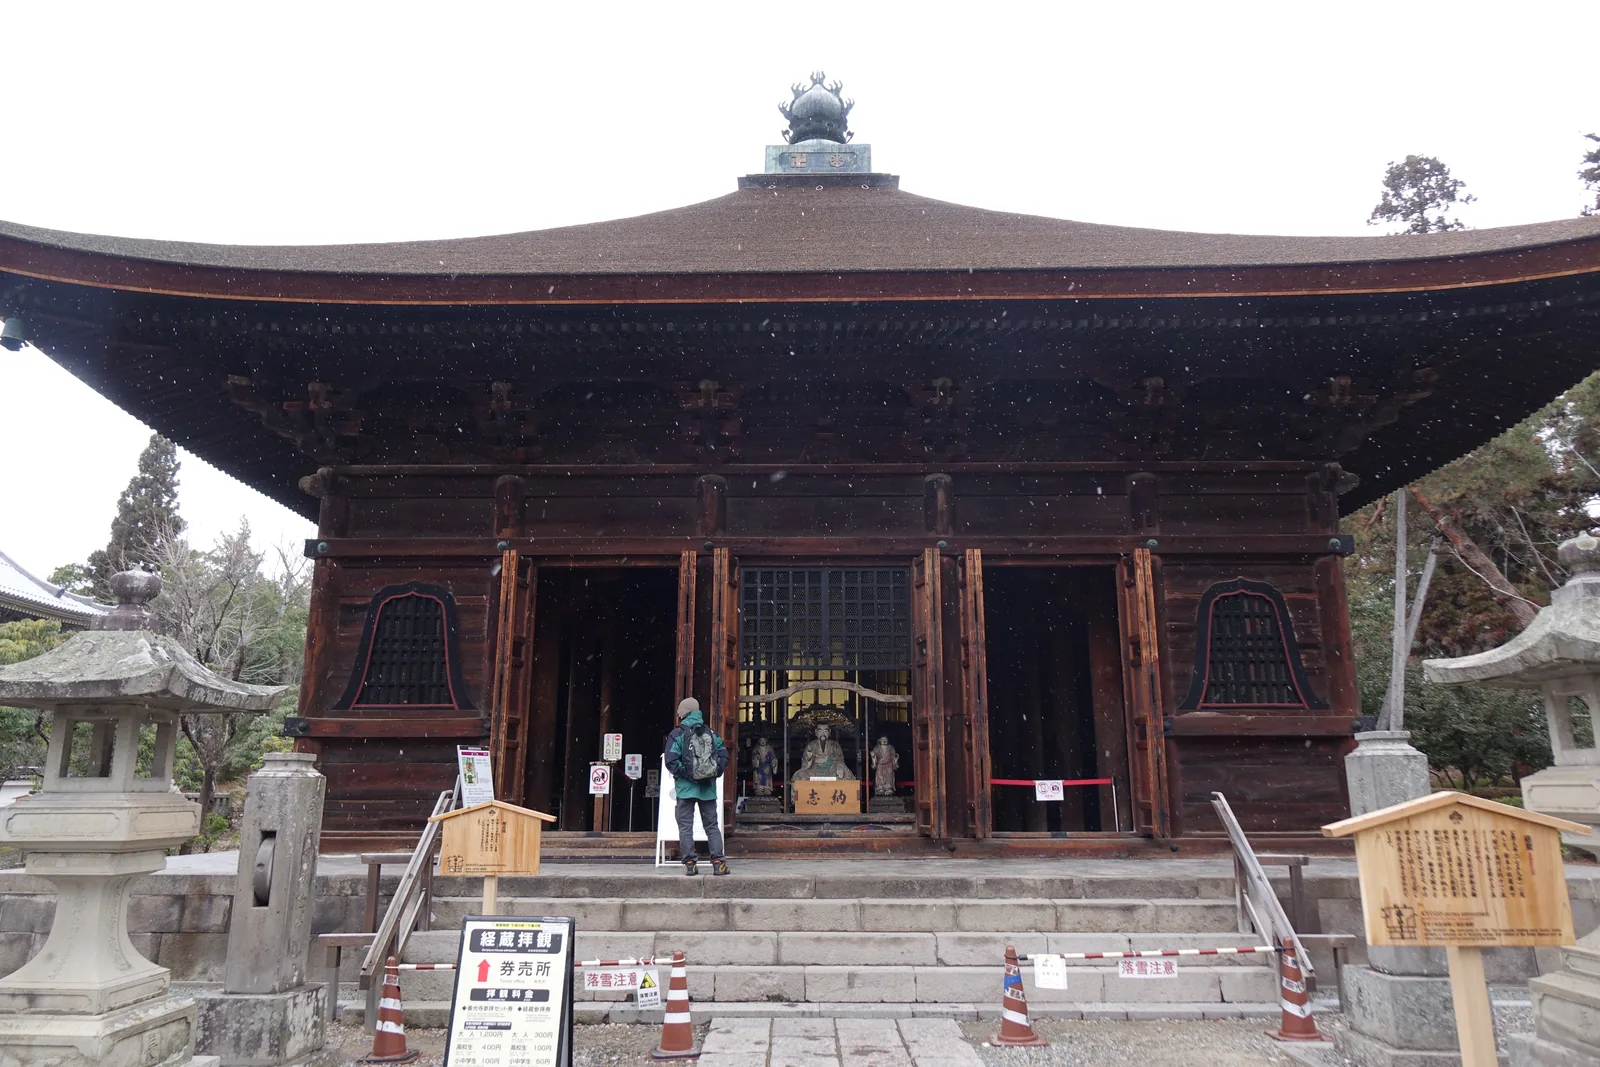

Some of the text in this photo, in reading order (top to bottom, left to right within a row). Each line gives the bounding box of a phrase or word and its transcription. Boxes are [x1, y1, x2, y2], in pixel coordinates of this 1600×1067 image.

[806, 788, 847, 806] 志納
[480, 931, 552, 948] 経蔵拝観
[500, 961, 551, 977] 券売所
[1121, 960, 1175, 974] 落雪注意
[587, 972, 637, 987] 落雪注意
[486, 989, 534, 999] 拝観料金
